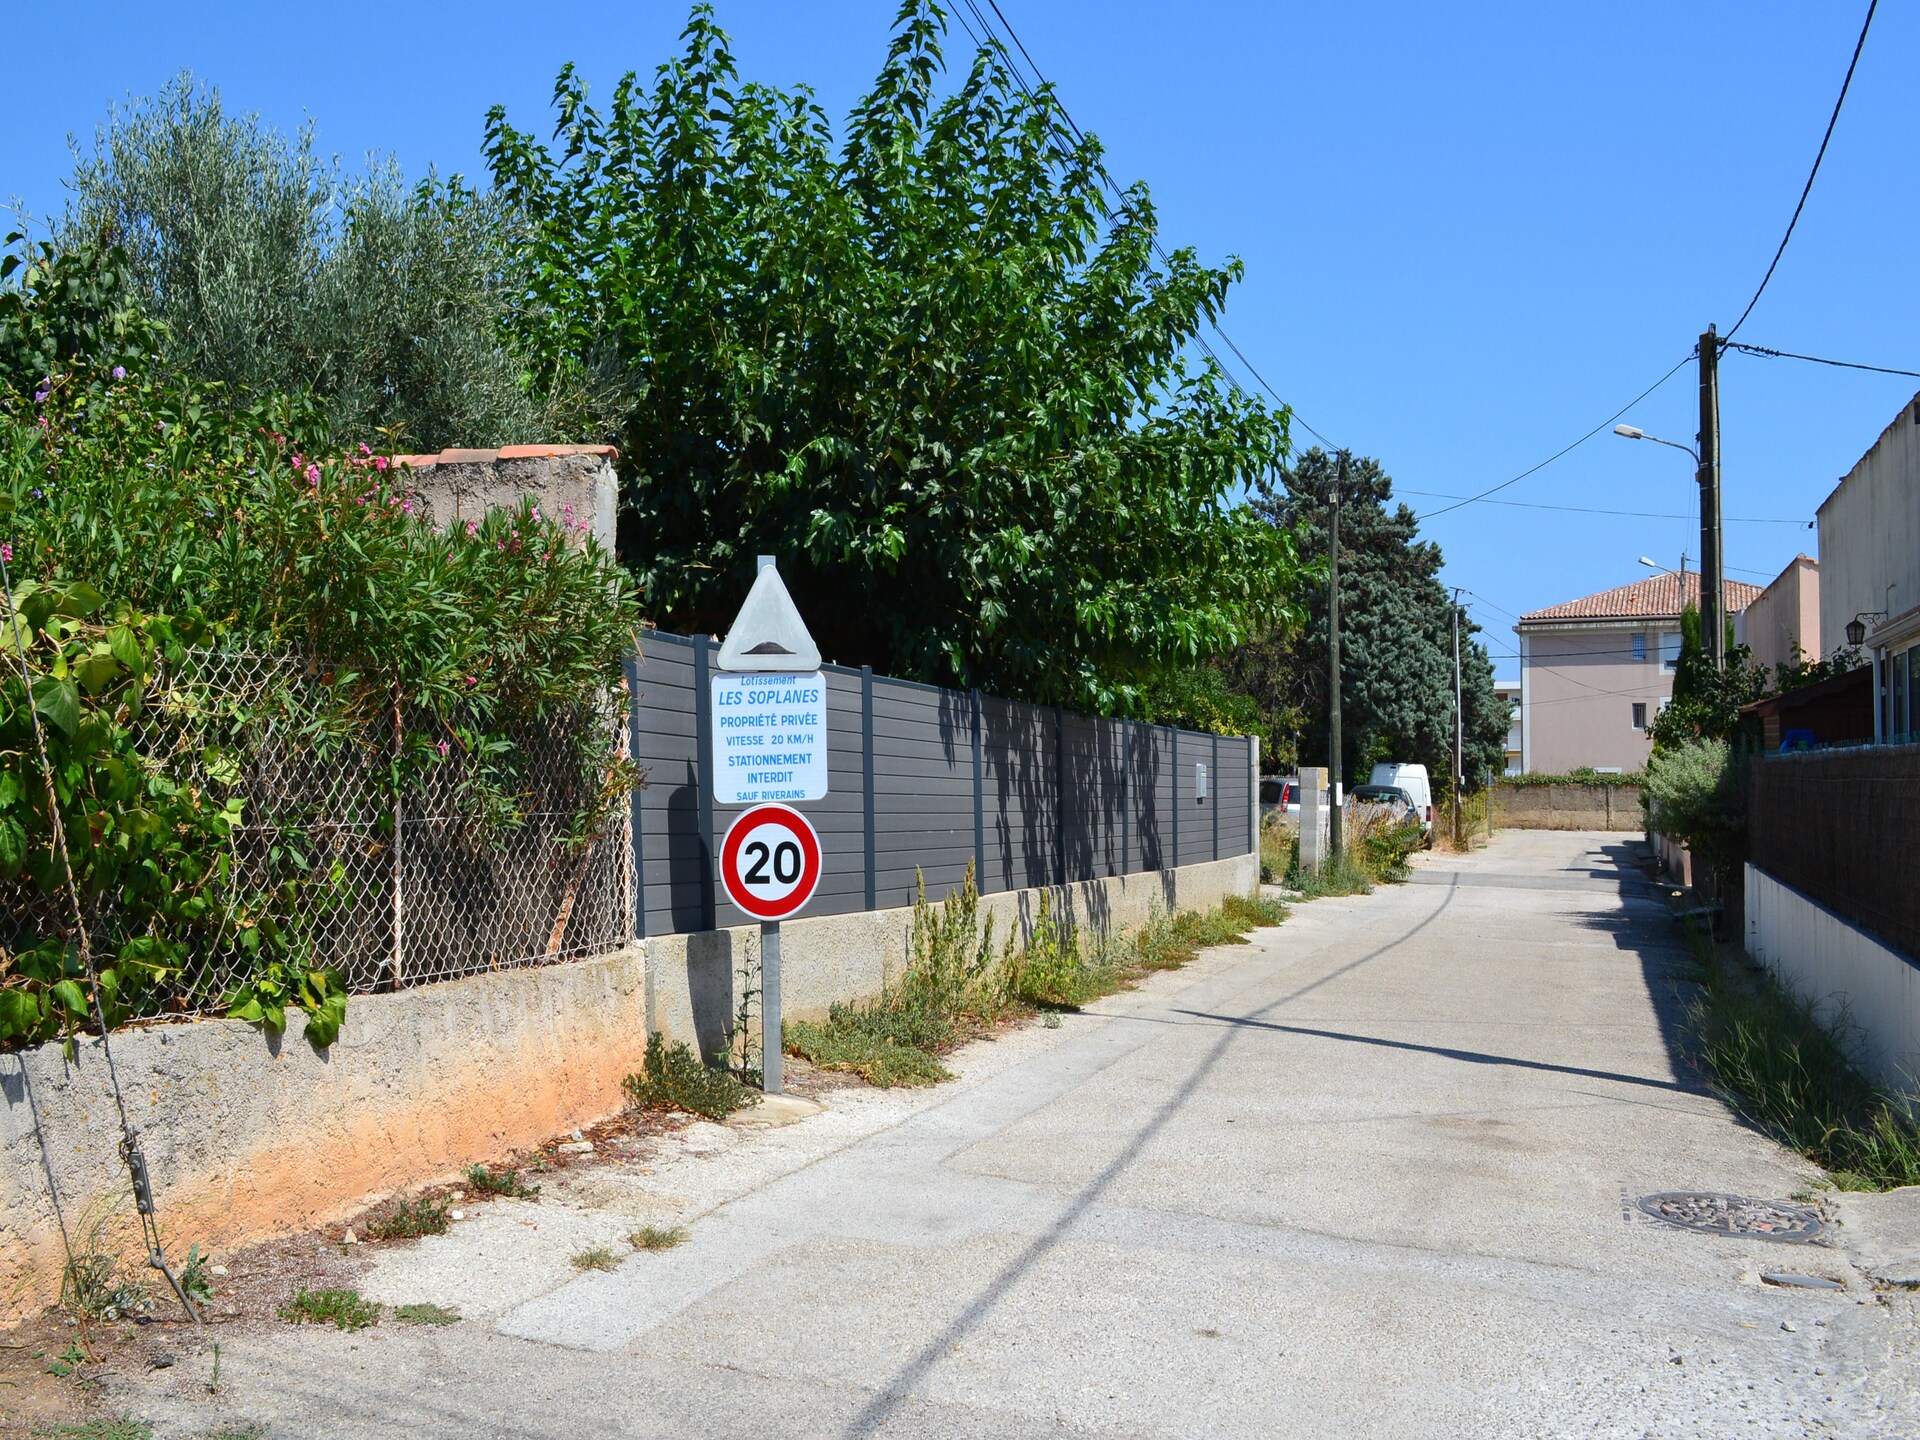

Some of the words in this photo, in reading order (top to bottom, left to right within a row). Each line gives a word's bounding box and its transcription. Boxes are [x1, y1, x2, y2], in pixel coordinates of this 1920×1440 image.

[740, 675, 796, 687] Lotissement
[718, 691, 743, 706] LES
[747, 688, 819, 705] SOPLANES
[720, 714, 777, 728] PROPRIÉTÉ
[781, 712, 818, 726] PRIVÉE
[726, 735, 764, 747] VITESSE
[771, 735, 784, 745] 20
[787, 734, 814, 745] KM/H
[728, 753, 812, 767] STATIONNEMENT
[747, 771, 793, 784] INTERDIT
[736, 791, 759, 802] SAUF
[762, 790, 806, 801] RIVERAINS
[744, 841, 801, 885] 20
